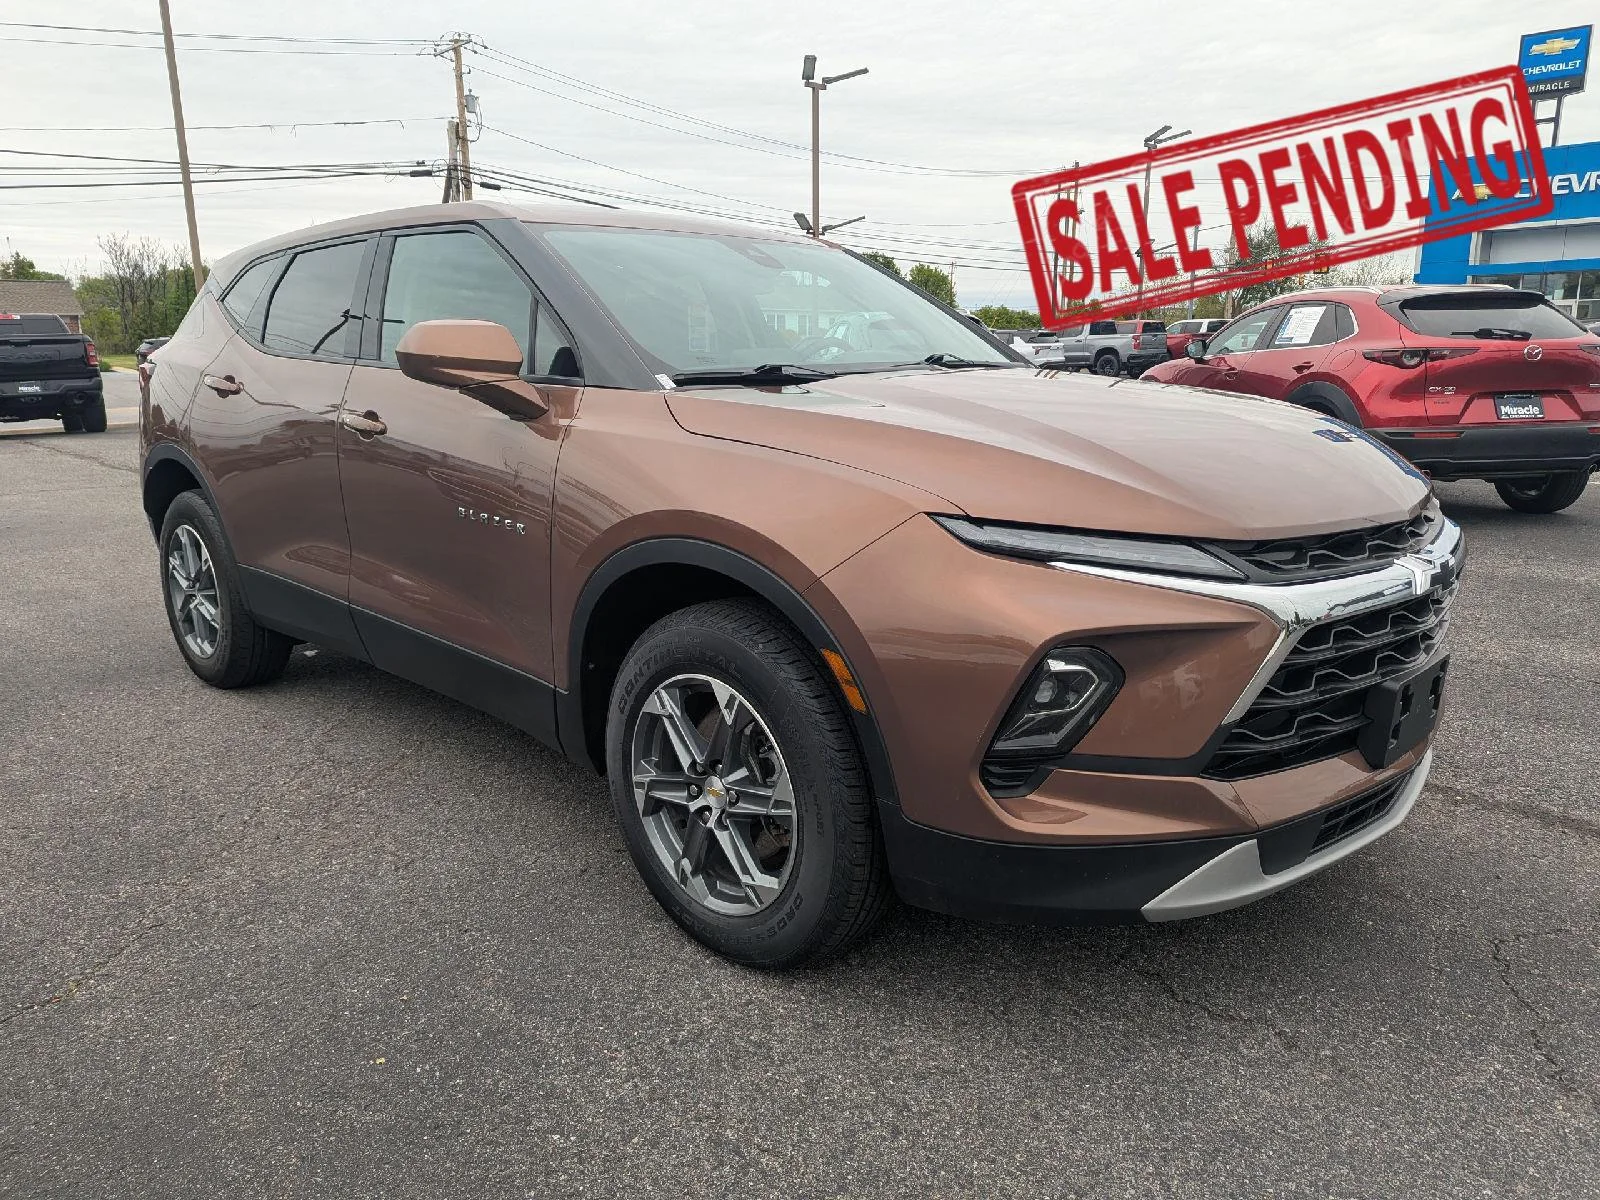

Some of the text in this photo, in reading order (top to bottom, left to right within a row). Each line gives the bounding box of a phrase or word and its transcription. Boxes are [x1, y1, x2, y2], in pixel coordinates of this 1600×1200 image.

[1522, 60, 1582, 75] CHEVROLET
[1528, 81, 1571, 93] MIRACLE
[1500, 405, 1540, 414] Miracle
[458, 507, 525, 535] BLAZER
